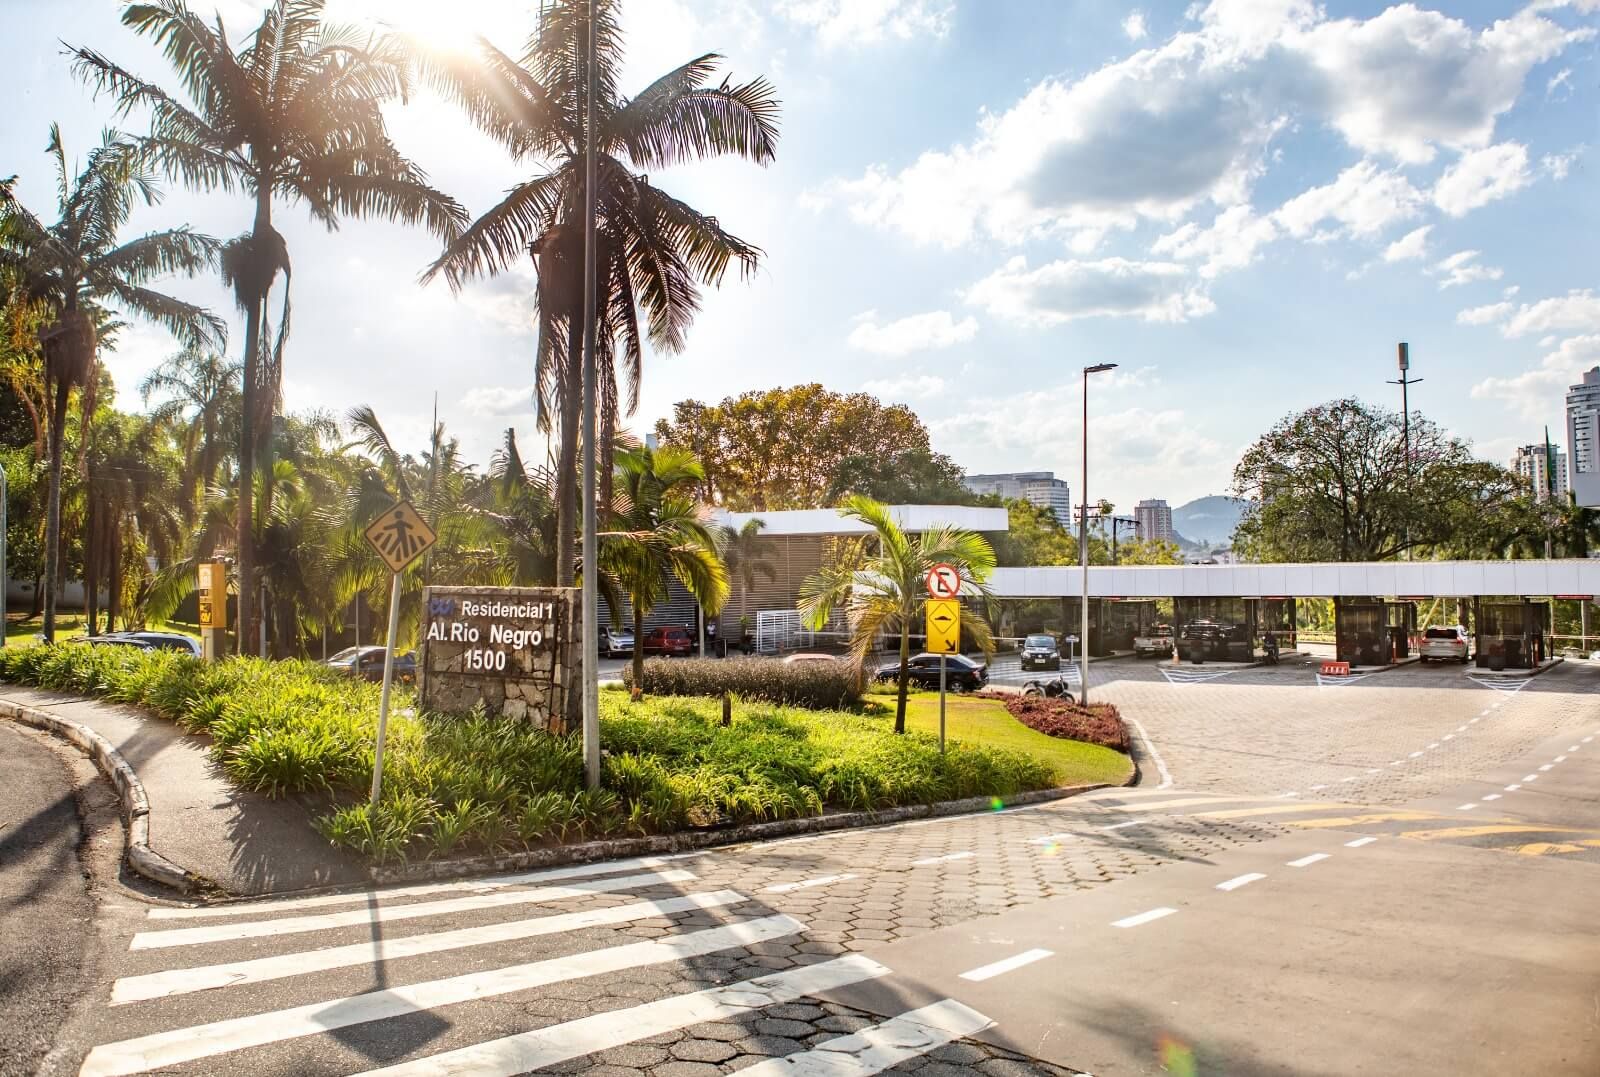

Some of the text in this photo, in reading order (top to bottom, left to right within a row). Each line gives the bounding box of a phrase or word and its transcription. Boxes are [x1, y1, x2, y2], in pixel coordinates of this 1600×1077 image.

[462, 600, 553, 619] Residencial 1
[427, 622, 542, 650] Al. Rio Negro
[464, 649, 506, 671] 1500
